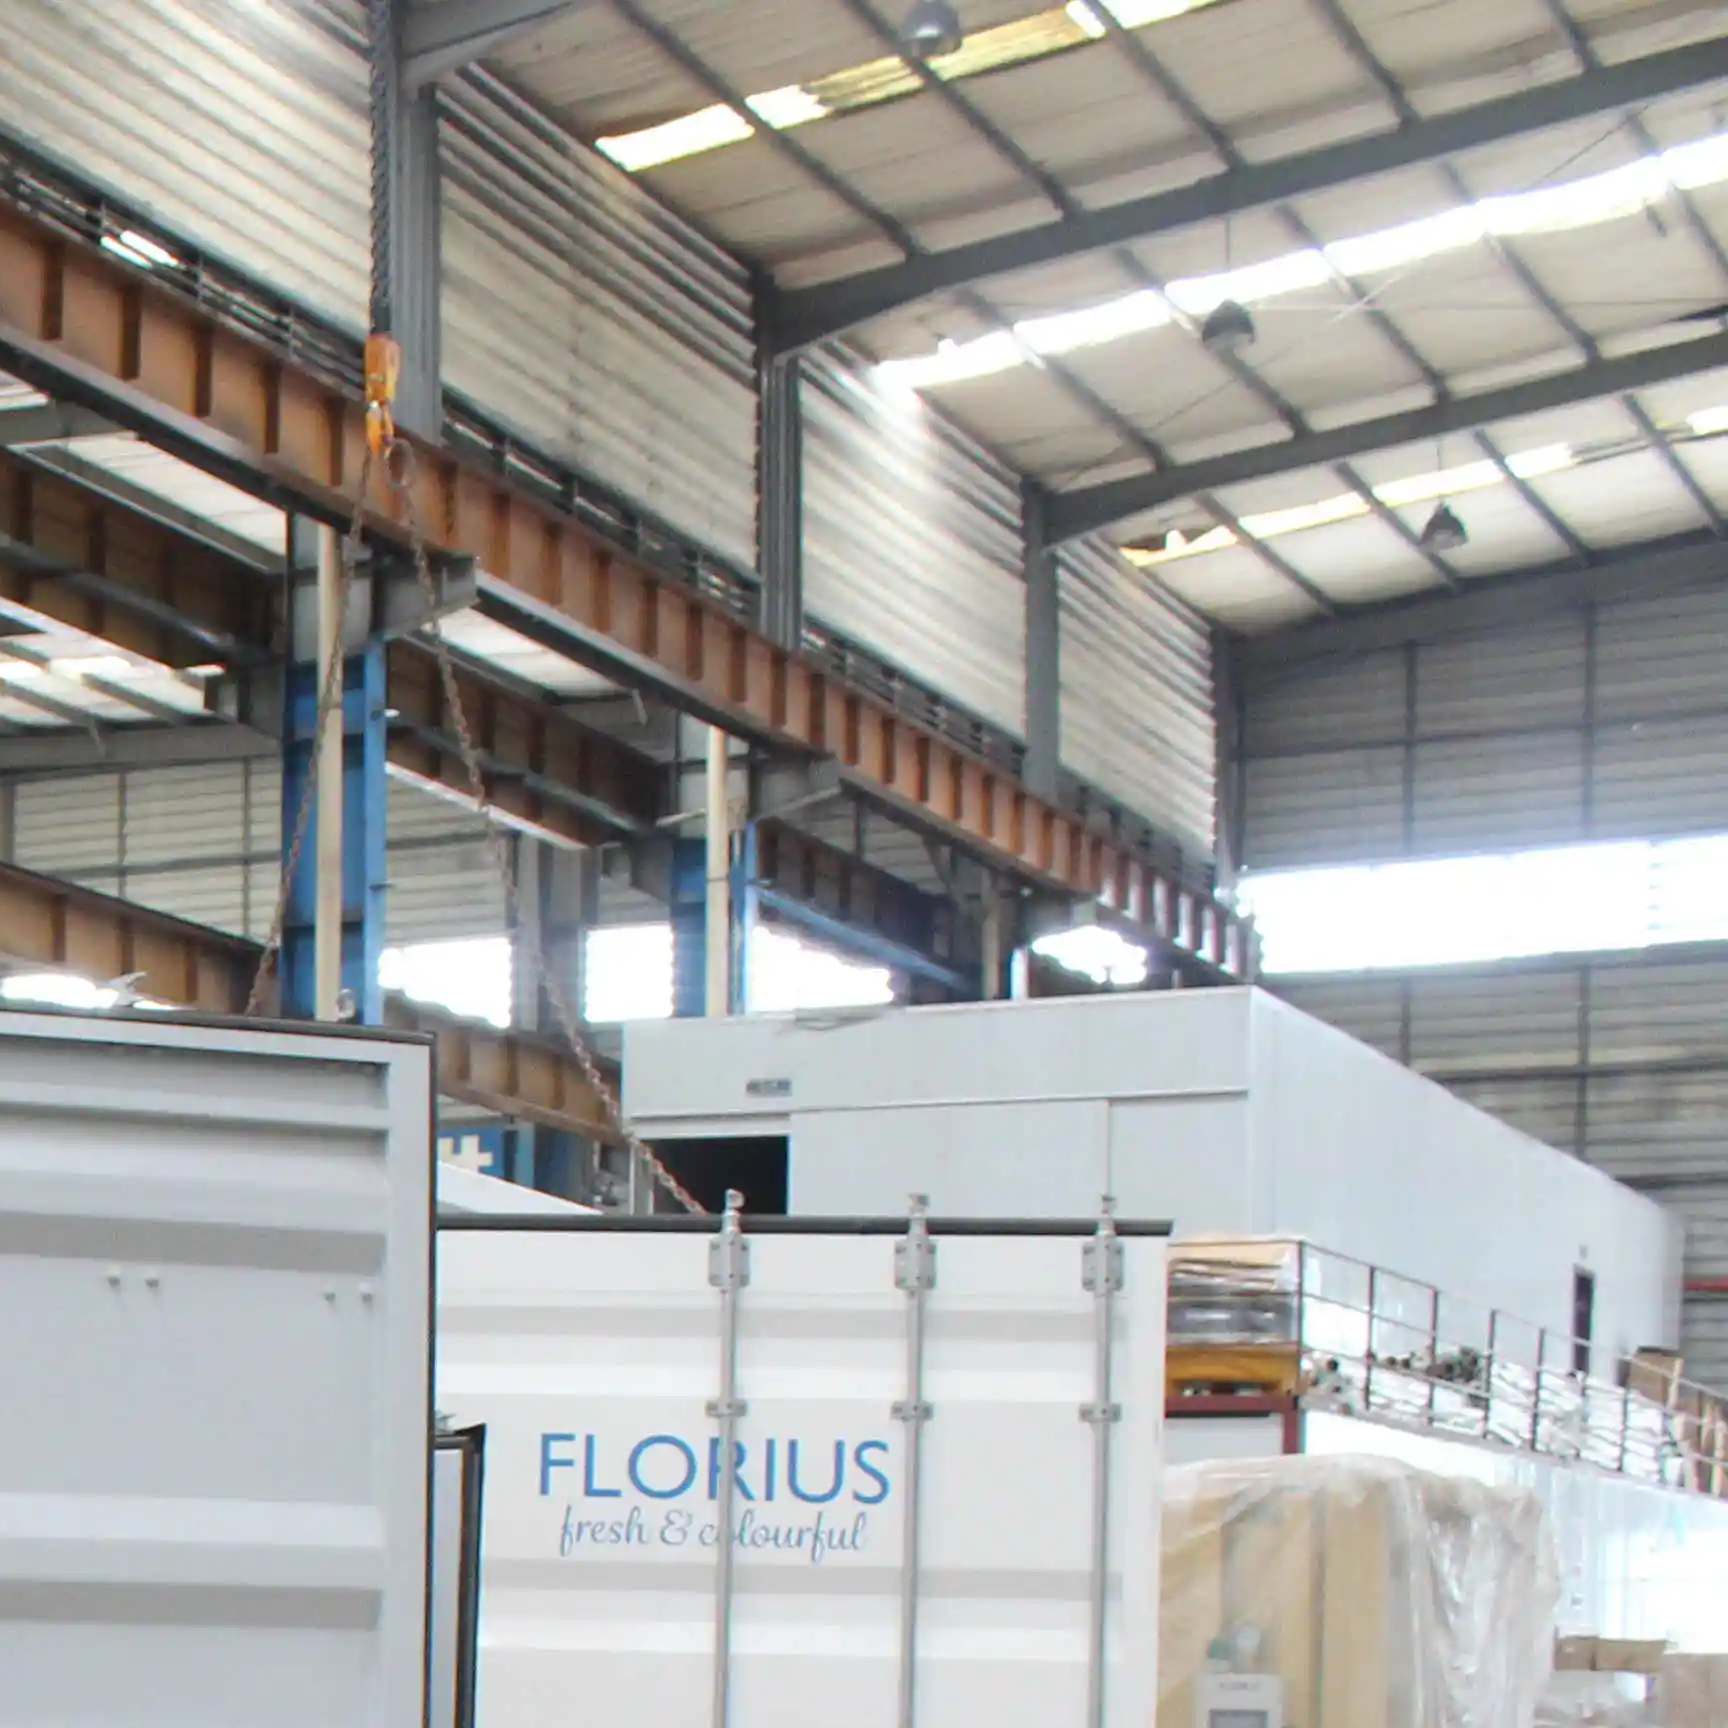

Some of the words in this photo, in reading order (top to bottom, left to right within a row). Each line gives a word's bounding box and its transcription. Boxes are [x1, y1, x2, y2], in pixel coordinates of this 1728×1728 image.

[538, 1432, 891, 1505] FLORIUS
[558, 1503, 648, 1558] fresh
[659, 1507, 694, 1546] &
[698, 1508, 869, 1564] clourful
